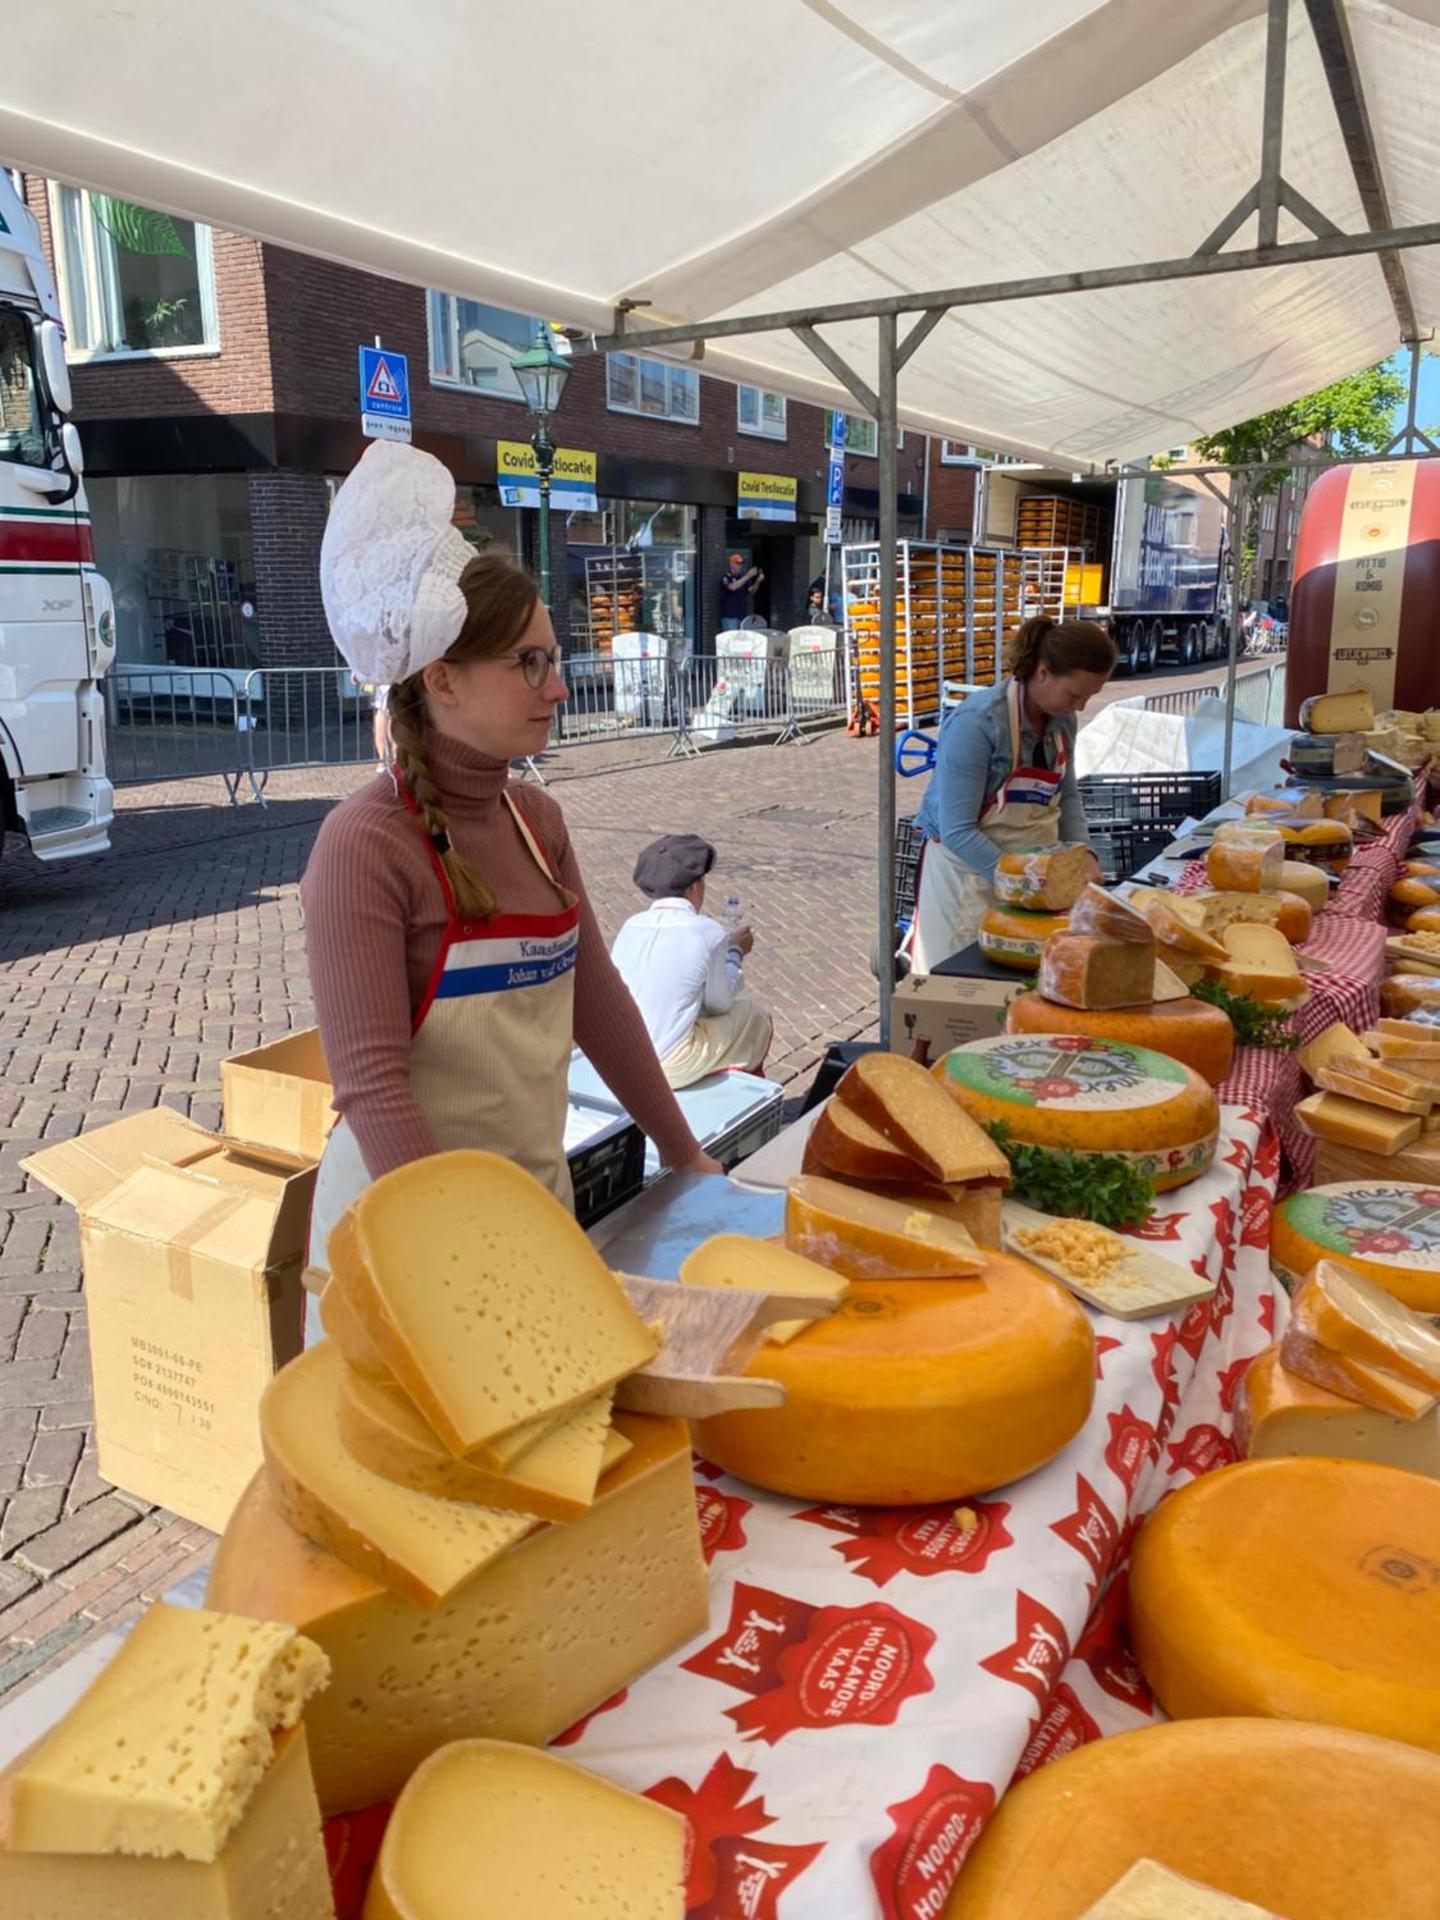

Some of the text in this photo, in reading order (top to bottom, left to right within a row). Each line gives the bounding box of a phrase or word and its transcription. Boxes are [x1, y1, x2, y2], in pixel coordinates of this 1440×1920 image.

[502, 451, 535, 469] Covid
[741, 480, 760, 493] Covid
[505, 967, 538, 985] Johan
[912, 1518, 941, 1541] KAAS
[818, 1646, 854, 1692] KAAS
[823, 1626, 887, 1718] HOLLANDSE
[857, 1643, 899, 1706] NOORD-
[916, 1813, 967, 1881] NOORD-
